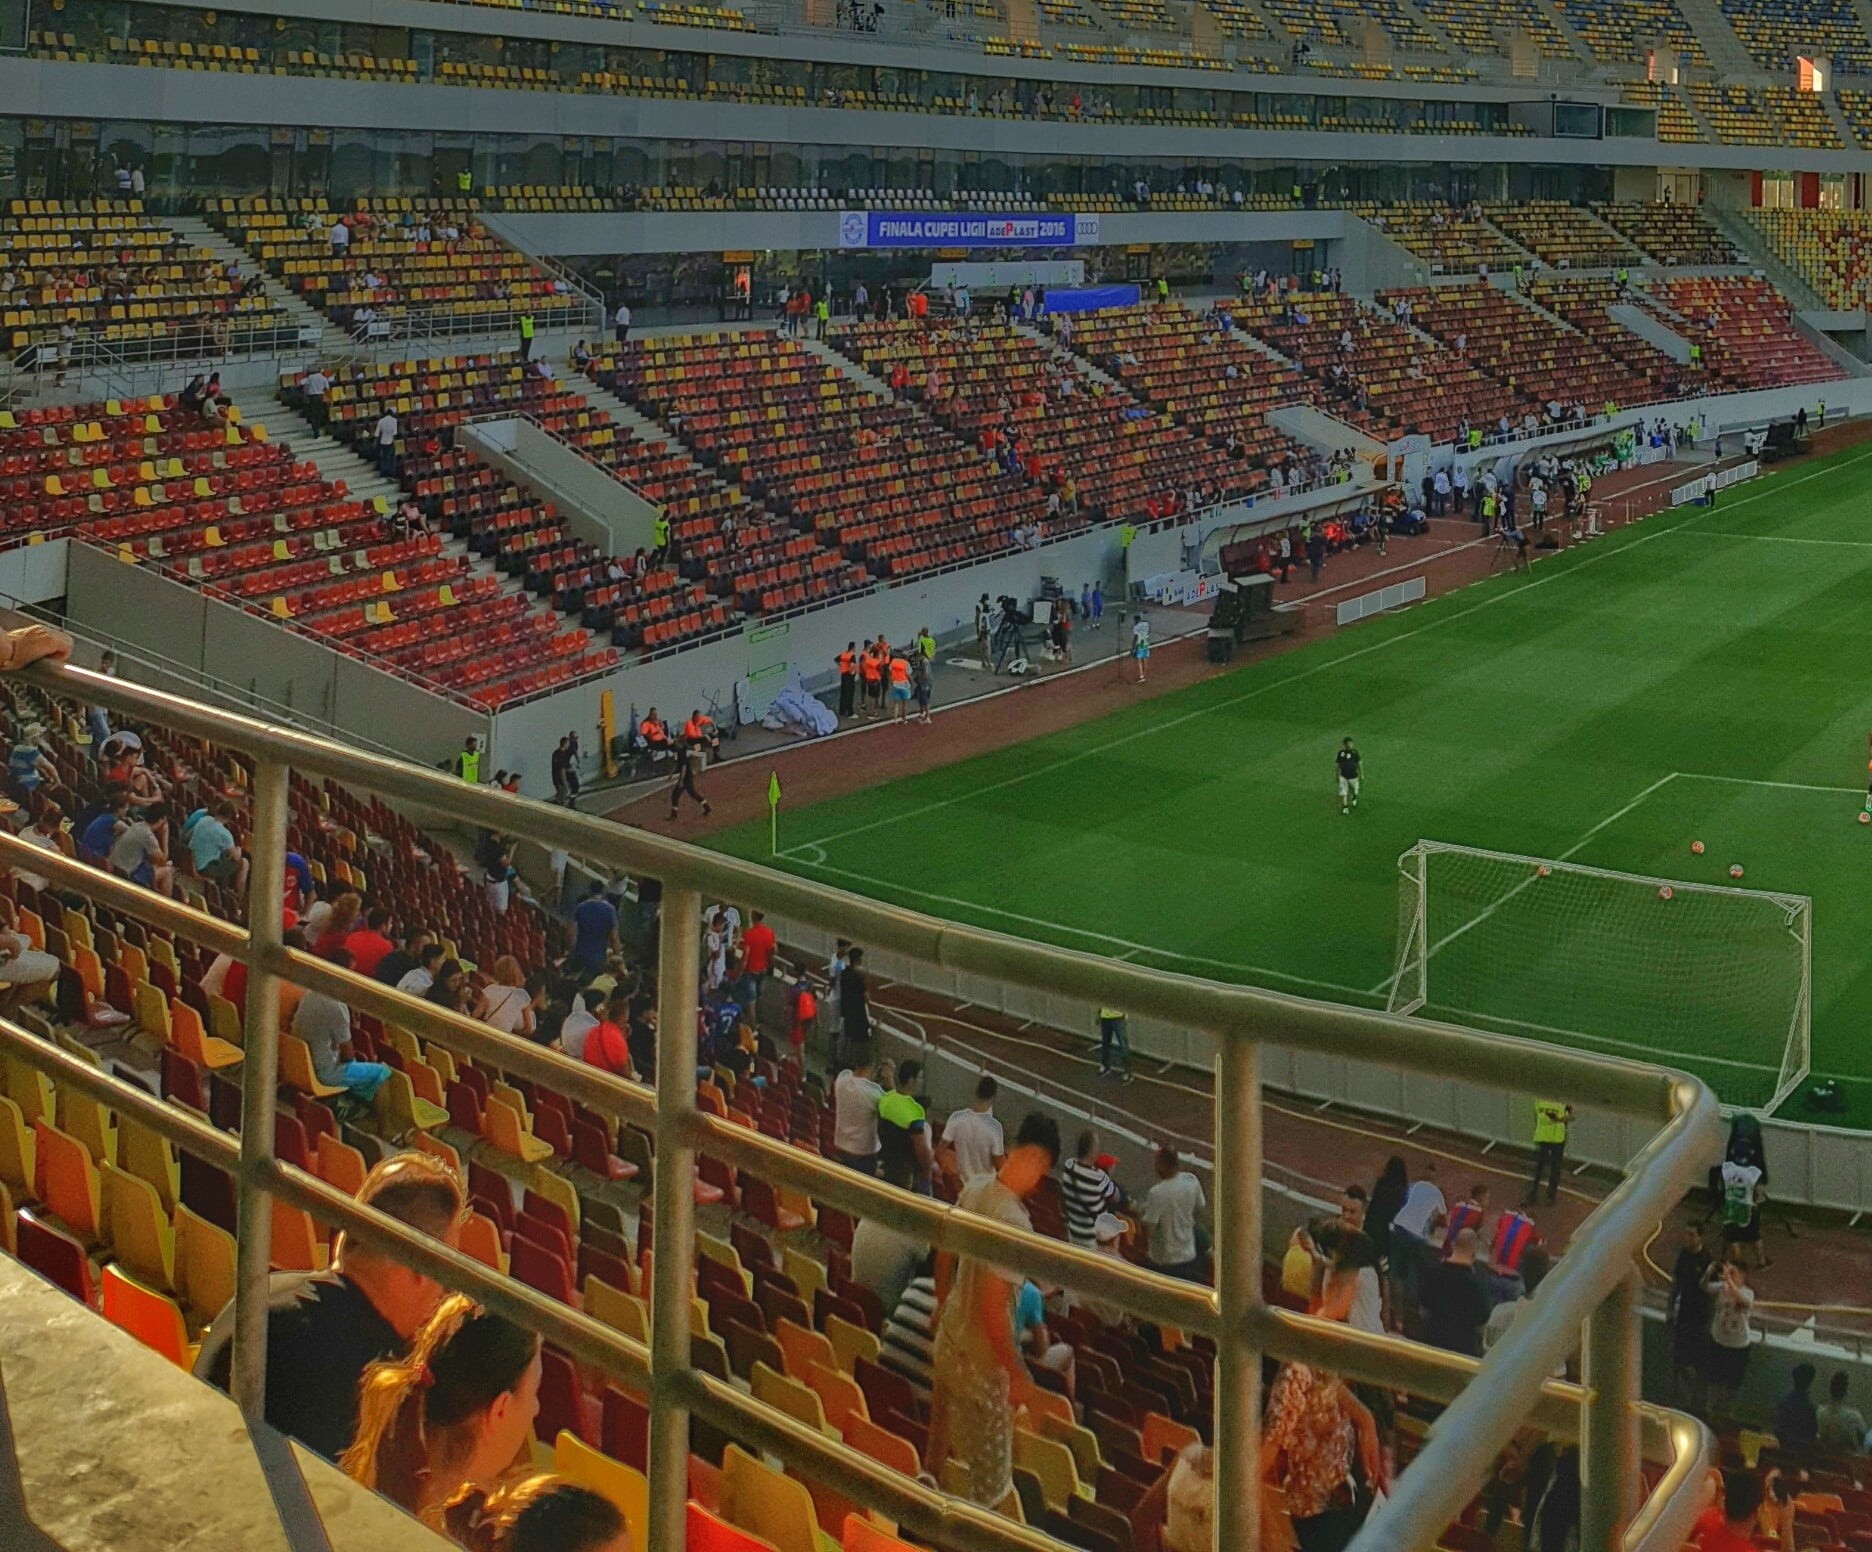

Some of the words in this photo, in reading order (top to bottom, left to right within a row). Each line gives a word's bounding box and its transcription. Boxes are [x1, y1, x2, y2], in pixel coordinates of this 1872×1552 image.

[879, 221, 923, 237] FINALA
[924, 221, 959, 238] CUPEI
[960, 221, 985, 237] LIGII
[989, 222, 1036, 236] ADEPLAST
[1039, 222, 1066, 236] 2016
